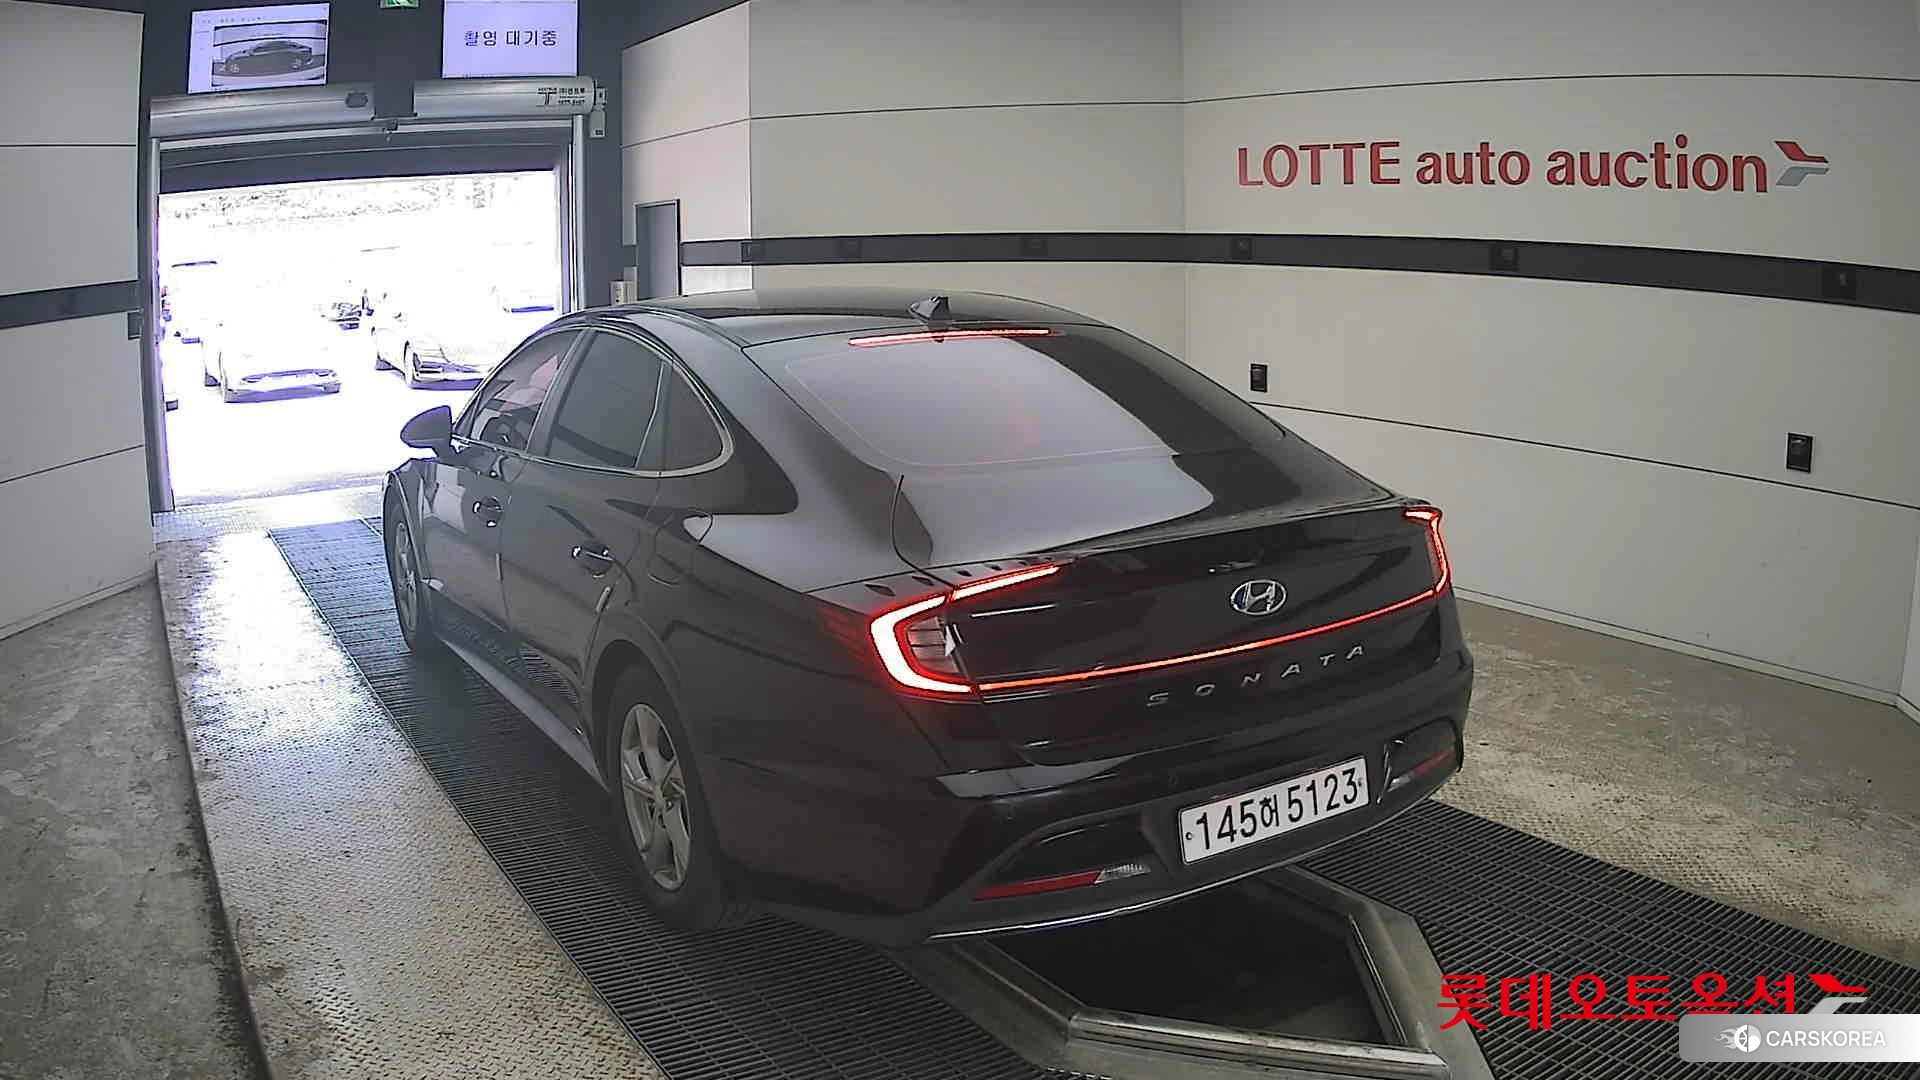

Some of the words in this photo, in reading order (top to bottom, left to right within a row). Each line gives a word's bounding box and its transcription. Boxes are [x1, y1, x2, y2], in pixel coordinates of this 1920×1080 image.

[505, 30, 557, 46] 대기중
[1237, 141, 1400, 188] LOTTE
[1415, 141, 1531, 186] auto
[1546, 135, 1768, 193] auction
[1146, 645, 1365, 707] SONATA
